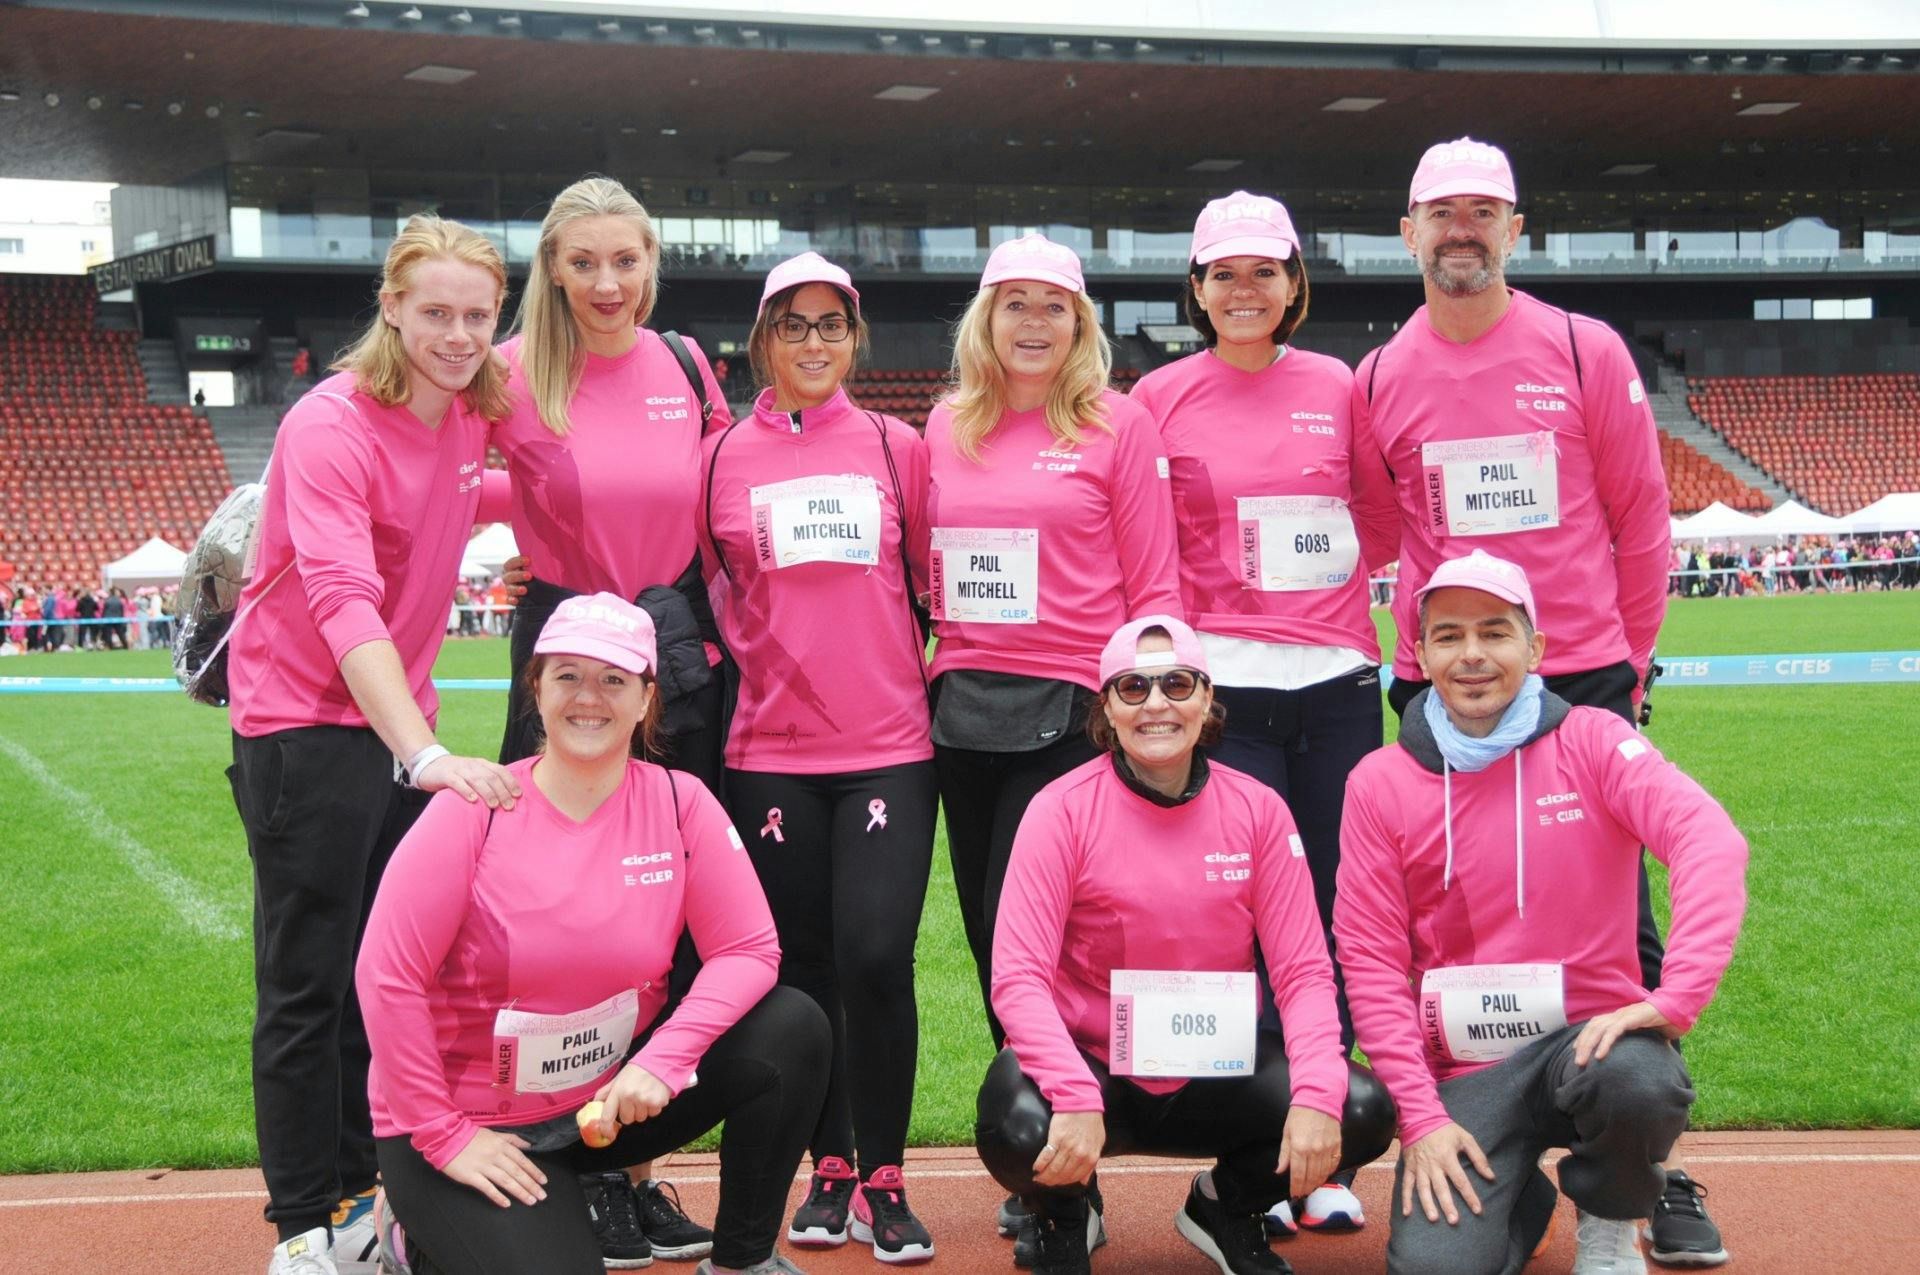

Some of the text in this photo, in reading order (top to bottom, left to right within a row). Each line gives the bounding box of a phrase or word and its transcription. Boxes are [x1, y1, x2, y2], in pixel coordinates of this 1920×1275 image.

[174, 241, 214, 273] OVAL
[1533, 399, 1567, 412] CLER
[1308, 424, 1336, 437] CLER
[1046, 462, 1077, 473] CLER
[1480, 463, 1518, 482] PAUL
[808, 499, 844, 515] PAUL
[1428, 472, 1443, 527] WALKER
[1465, 489, 1537, 511] MITCHELL
[1520, 513, 1549, 525] CLER
[756, 510, 771, 561] WALKER
[793, 523, 862, 541] MITCHELL
[1294, 533, 1331, 554] 6089
[845, 548, 871, 560] CLER
[1244, 527, 1257, 580] WALKER
[970, 555, 1002, 572] PAUL
[933, 557, 942, 610] WALKER
[1326, 573, 1348, 584] CLER
[957, 581, 1018, 599] MITCHELL
[1000, 609, 1028, 618] CLER
[1556, 808, 1585, 823] CLER
[640, 869, 674, 885] CLER
[1222, 868, 1250, 881] CLER
[1481, 994, 1522, 1013] PAUL
[1116, 1003, 1128, 1062] WALKER
[1171, 1013, 1217, 1036] 6088
[1425, 999, 1444, 1051] WALKER
[1467, 1021, 1546, 1041] MITCHELL
[562, 1027, 601, 1051] PAUL
[499, 1043, 512, 1085] WALKER
[541, 1042, 615, 1075] MITCHELL
[1212, 1060, 1245, 1071] CLER
